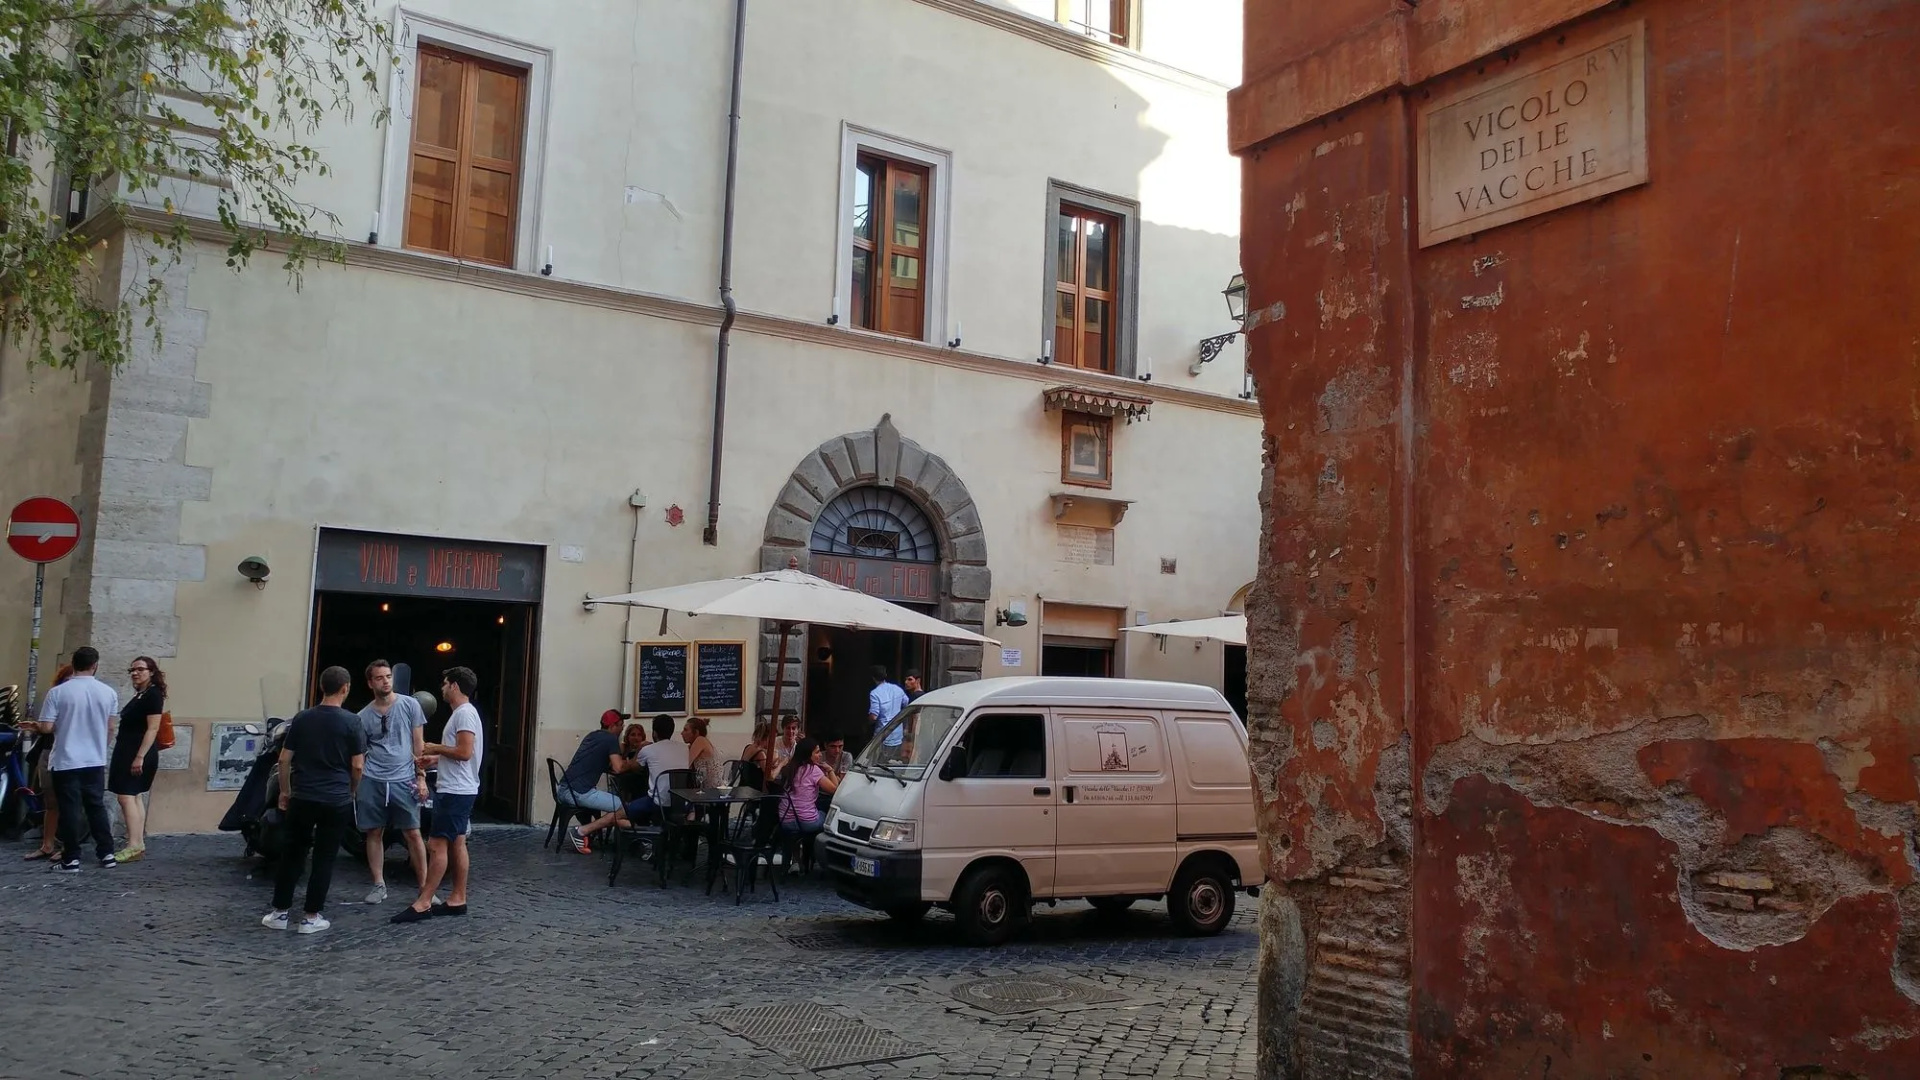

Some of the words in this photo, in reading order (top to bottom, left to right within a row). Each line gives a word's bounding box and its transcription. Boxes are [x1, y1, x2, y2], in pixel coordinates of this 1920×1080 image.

[1463, 79, 1588, 142] VICOLO
[1480, 121, 1569, 172] DELLE
[1455, 148, 1597, 213] VACCHE
[359, 541, 399, 585] VINI
[406, 564, 417, 587] e
[426, 548, 503, 591] MERENDE
[892, 565, 930, 599] FICO
